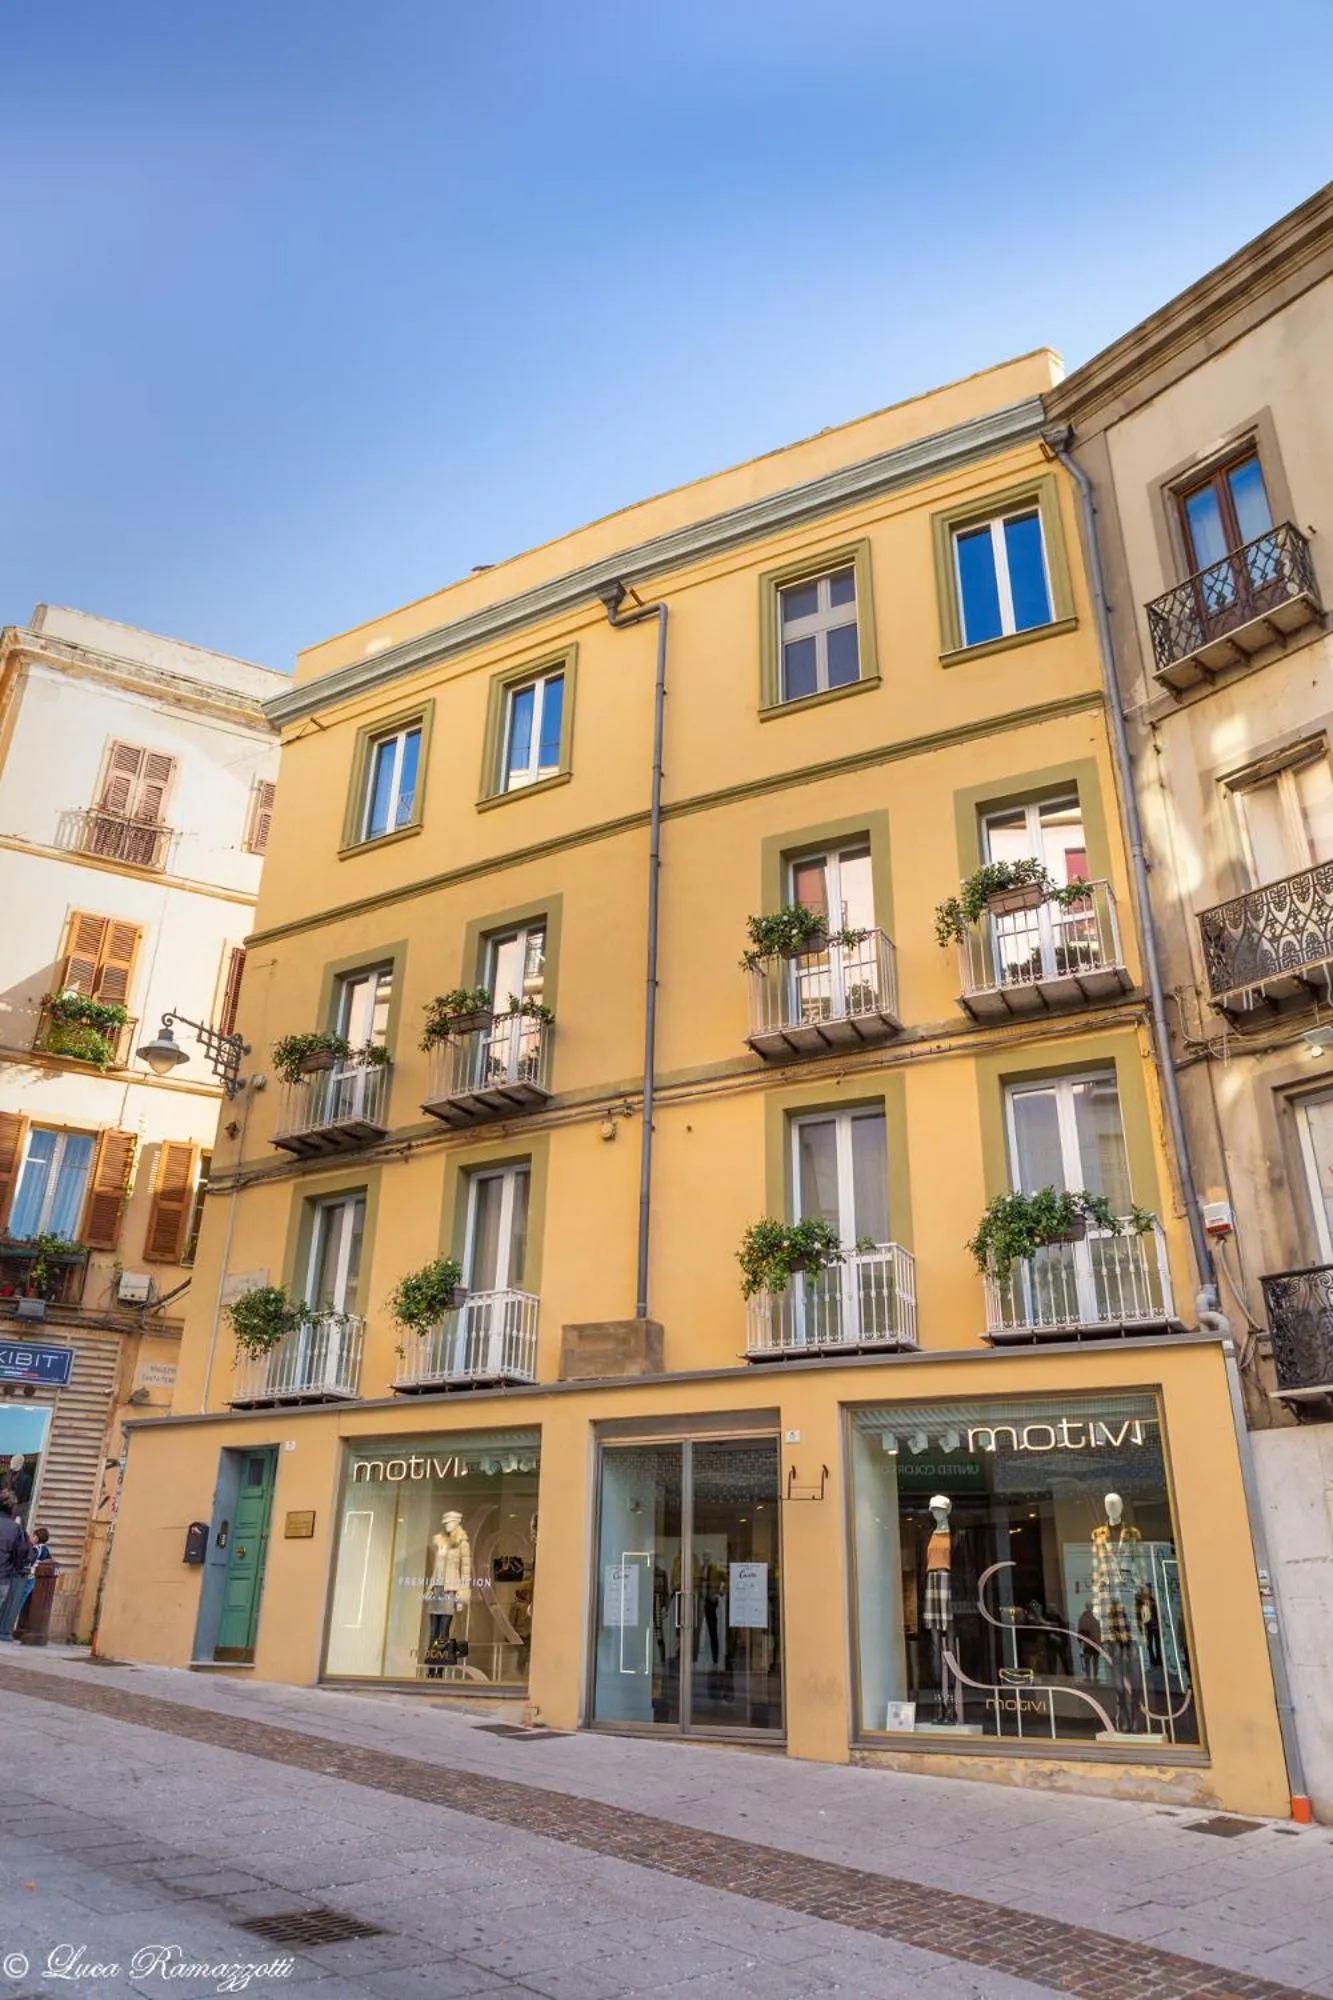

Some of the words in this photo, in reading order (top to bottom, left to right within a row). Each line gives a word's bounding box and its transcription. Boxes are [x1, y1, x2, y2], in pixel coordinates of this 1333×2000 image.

[968, 1418, 1143, 1453] motivi
[352, 1455, 459, 1483] motivi
[985, 1698, 1047, 1713] motivi
